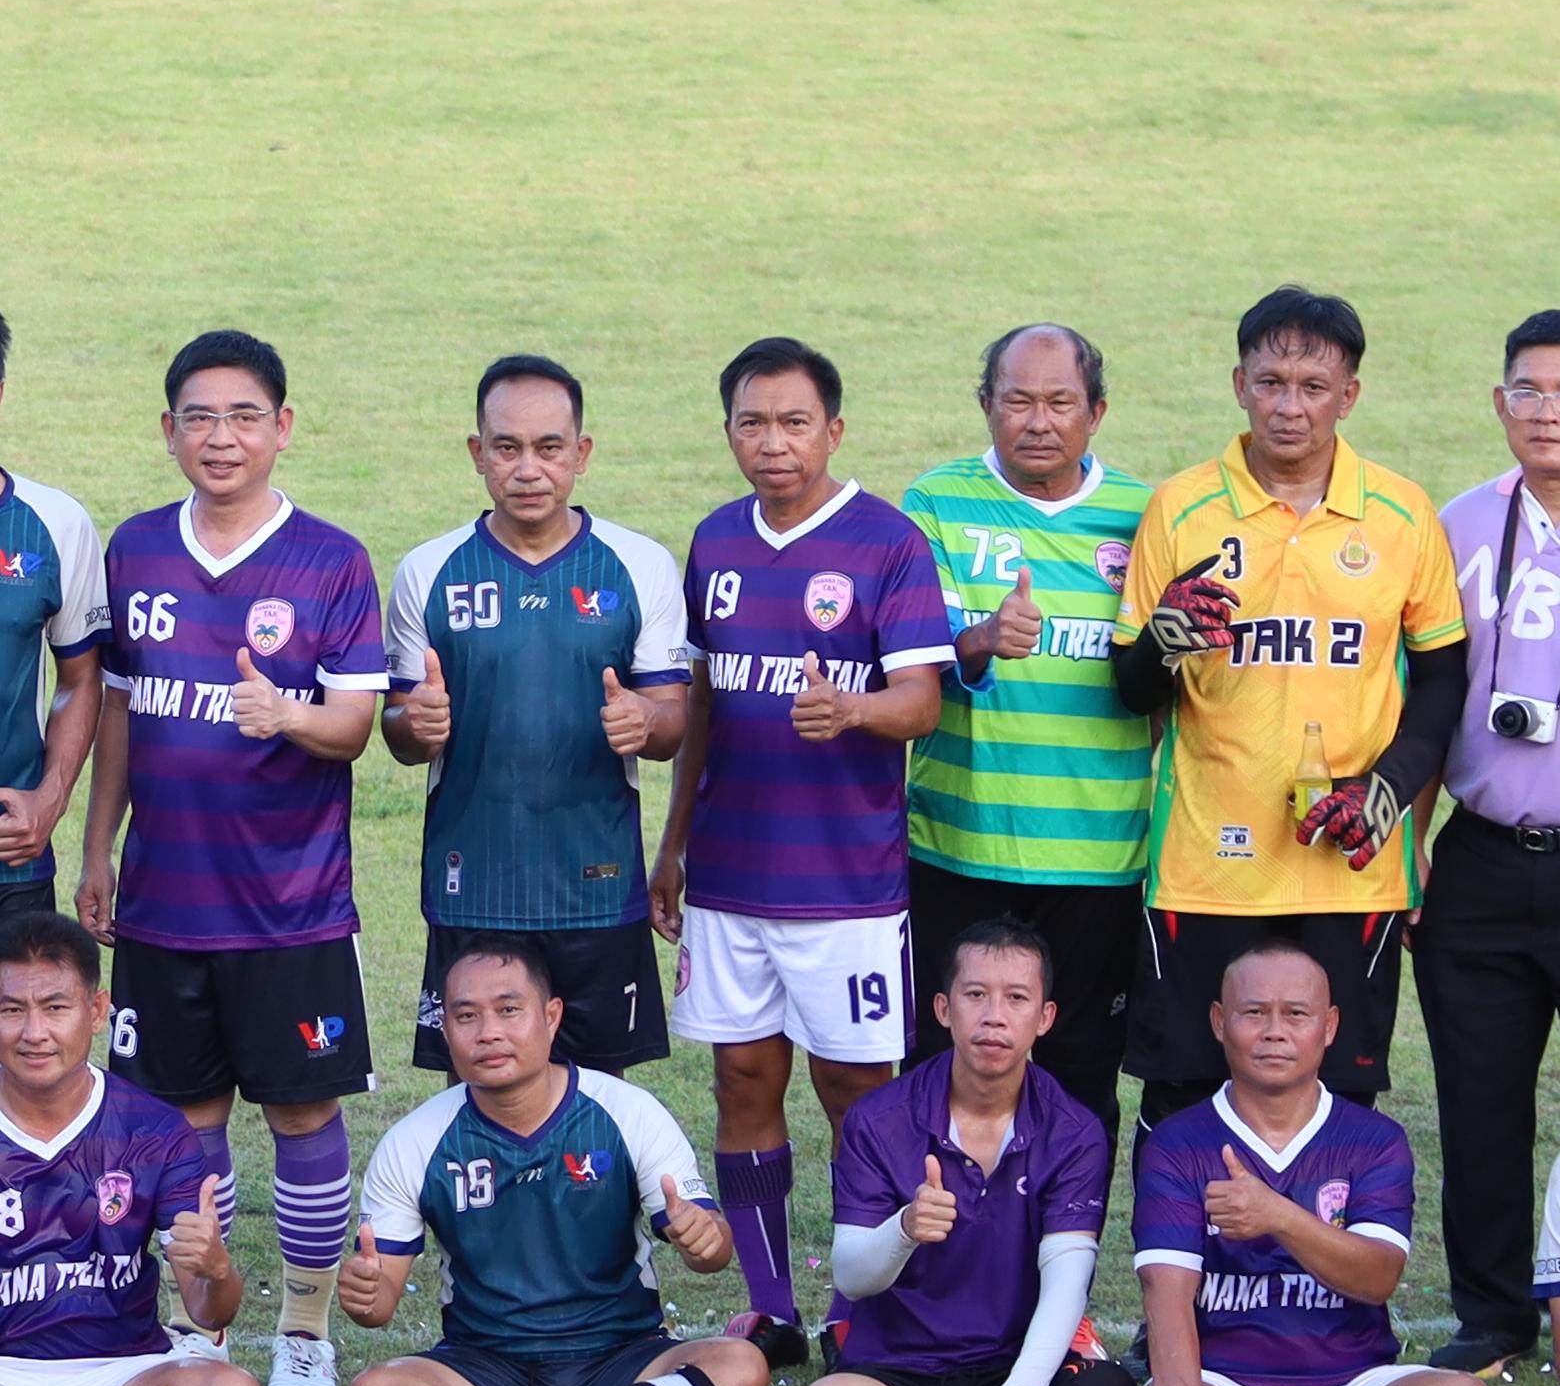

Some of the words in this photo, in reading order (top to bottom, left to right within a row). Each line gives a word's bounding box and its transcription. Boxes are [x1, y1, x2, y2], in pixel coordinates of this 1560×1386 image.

[963, 527, 1022, 581] 72
[1220, 537, 1244, 580] 3
[128, 591, 179, 643] 66
[445, 581, 501, 632] 50
[705, 569, 742, 621] 19
[1226, 618, 1316, 667] TAK
[1328, 618, 1367, 667] 2
[189, 681, 234, 725] TRE
[847, 971, 891, 1024] 19
[109, 1007, 139, 1059] 6
[446, 1158, 496, 1213] 18
[1195, 1272, 1270, 1314] NANA
